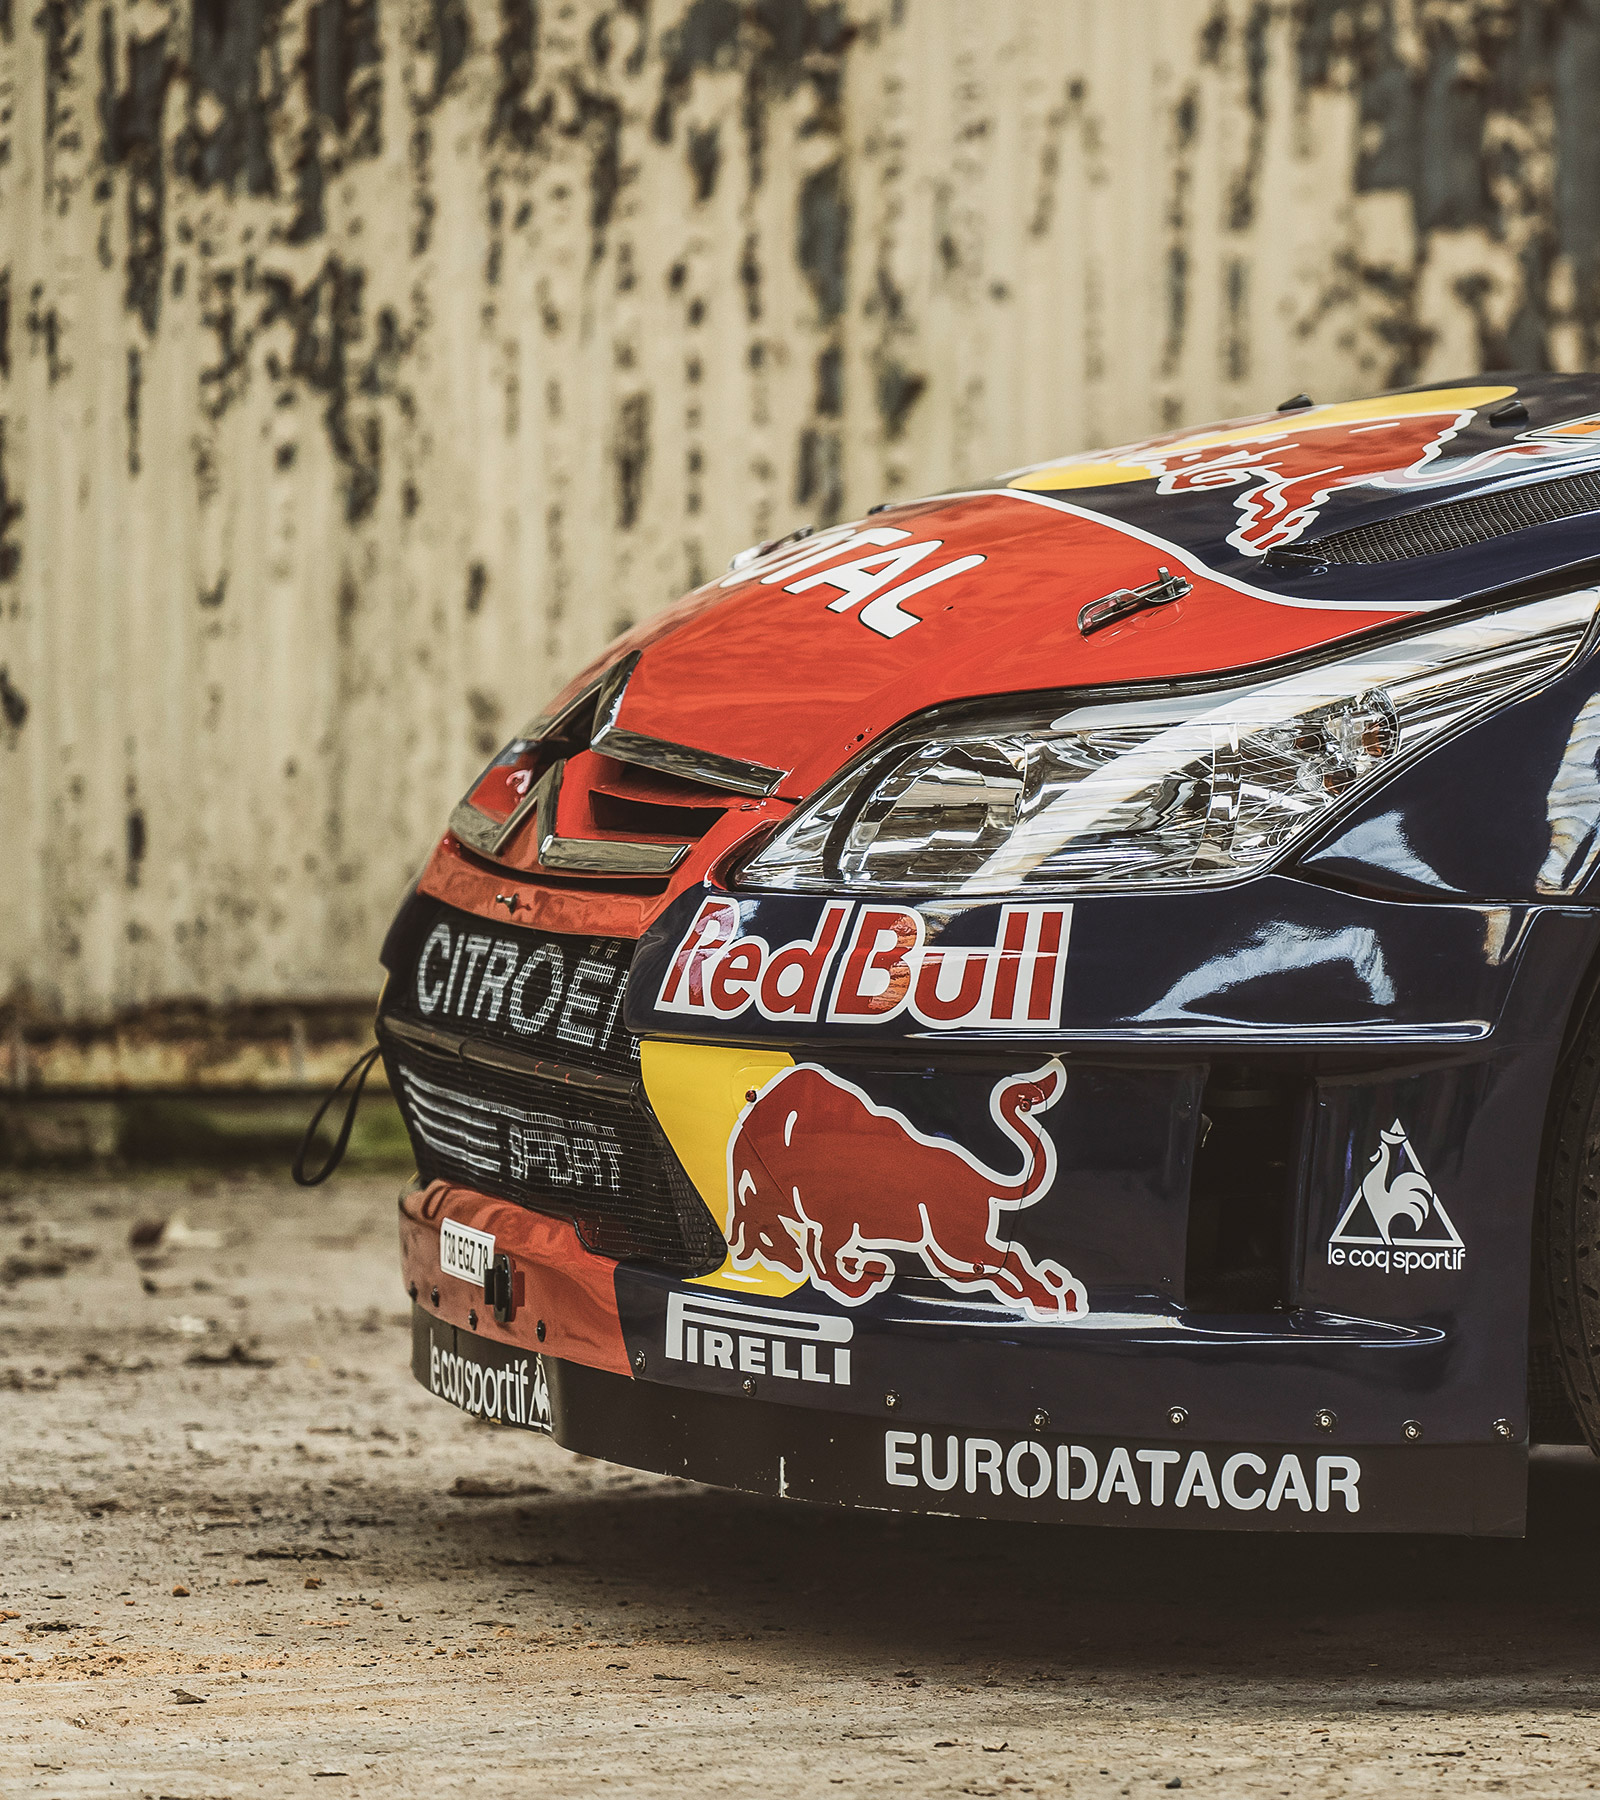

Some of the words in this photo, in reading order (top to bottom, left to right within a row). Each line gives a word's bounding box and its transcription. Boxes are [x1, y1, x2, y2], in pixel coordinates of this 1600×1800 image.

[654, 896, 855, 1022] Red
[826, 903, 1074, 1029] Bull
[457, 1236, 476, 1275] EGZ
[477, 1243, 489, 1276] 78
[1328, 1243, 1346, 1266] le
[1348, 1249, 1389, 1274] coq
[1393, 1248, 1466, 1274] sportif
[430, 1327, 440, 1394] le
[441, 1350, 465, 1410] coq
[465, 1360, 529, 1424] sportif
[665, 1292, 854, 1385] PIRELLI
[885, 1430, 1361, 1513] EURODATACAR
